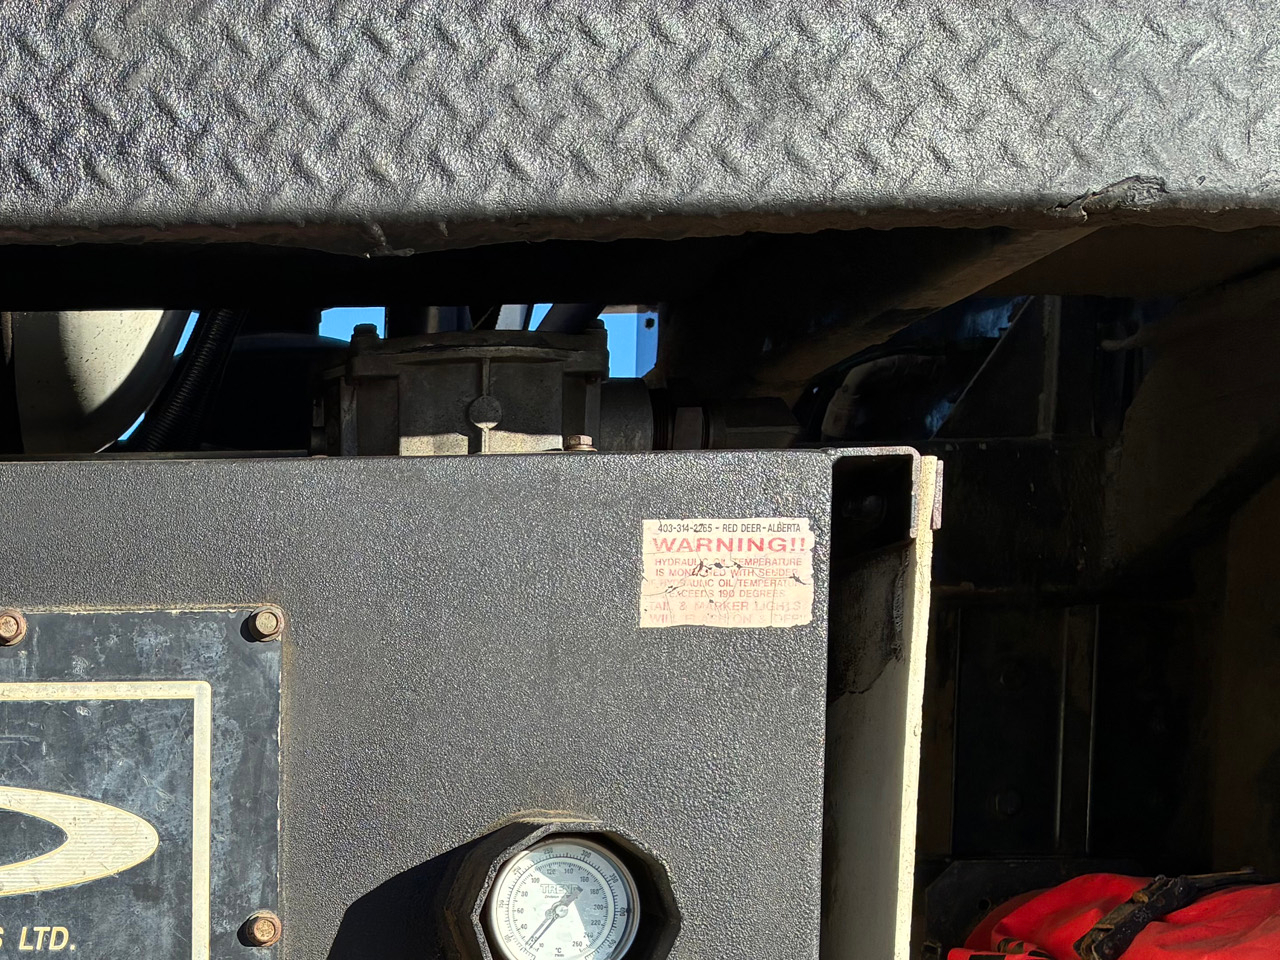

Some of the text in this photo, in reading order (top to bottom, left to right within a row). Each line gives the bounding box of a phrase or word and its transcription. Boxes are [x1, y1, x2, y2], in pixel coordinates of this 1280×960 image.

[657, 523, 713, 533] 403-314-2265
[722, 523, 738, 533] RED
[652, 537, 806, 553] WARNING!!
[654, 558, 709, 567] HYDRAULC
[732, 557, 803, 567] TEMPERATURE
[655, 568, 665, 577] IS
[730, 568, 755, 577] WITH
[717, 579, 734, 588] OIL
[718, 589, 735, 598] 190
[739, 589, 786, 598] DEGREES
[18, 925, 77, 952] LTD.
